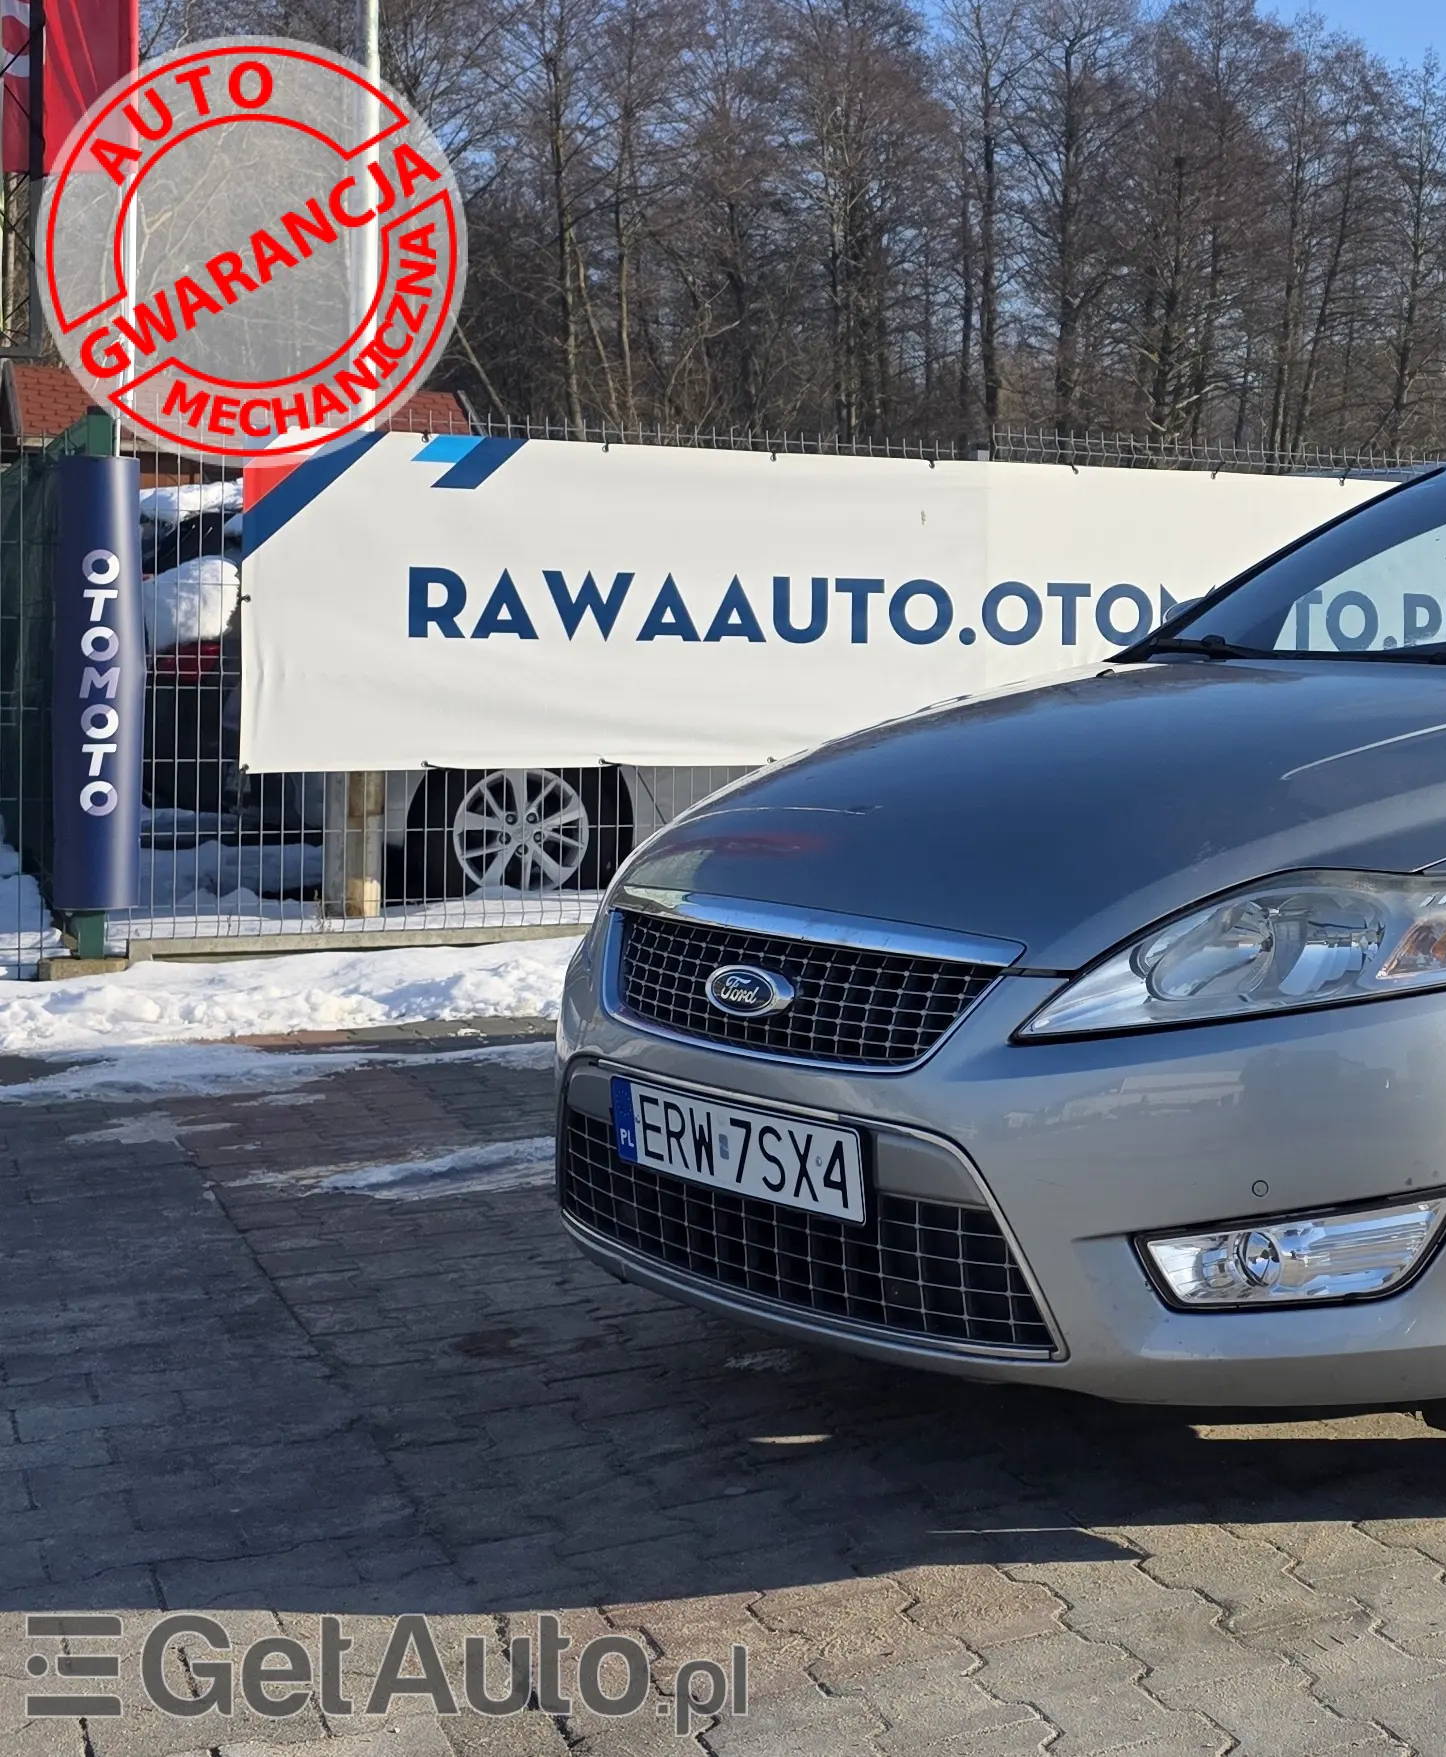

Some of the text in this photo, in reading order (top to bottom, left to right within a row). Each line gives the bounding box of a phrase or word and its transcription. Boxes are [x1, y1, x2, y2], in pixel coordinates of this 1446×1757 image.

[79, 548, 120, 817] OTOMOTO
[721, 975, 760, 1004] Ford
[620, 1128, 635, 1148] PL
[639, 1094, 849, 1209] ERW 7SX4
